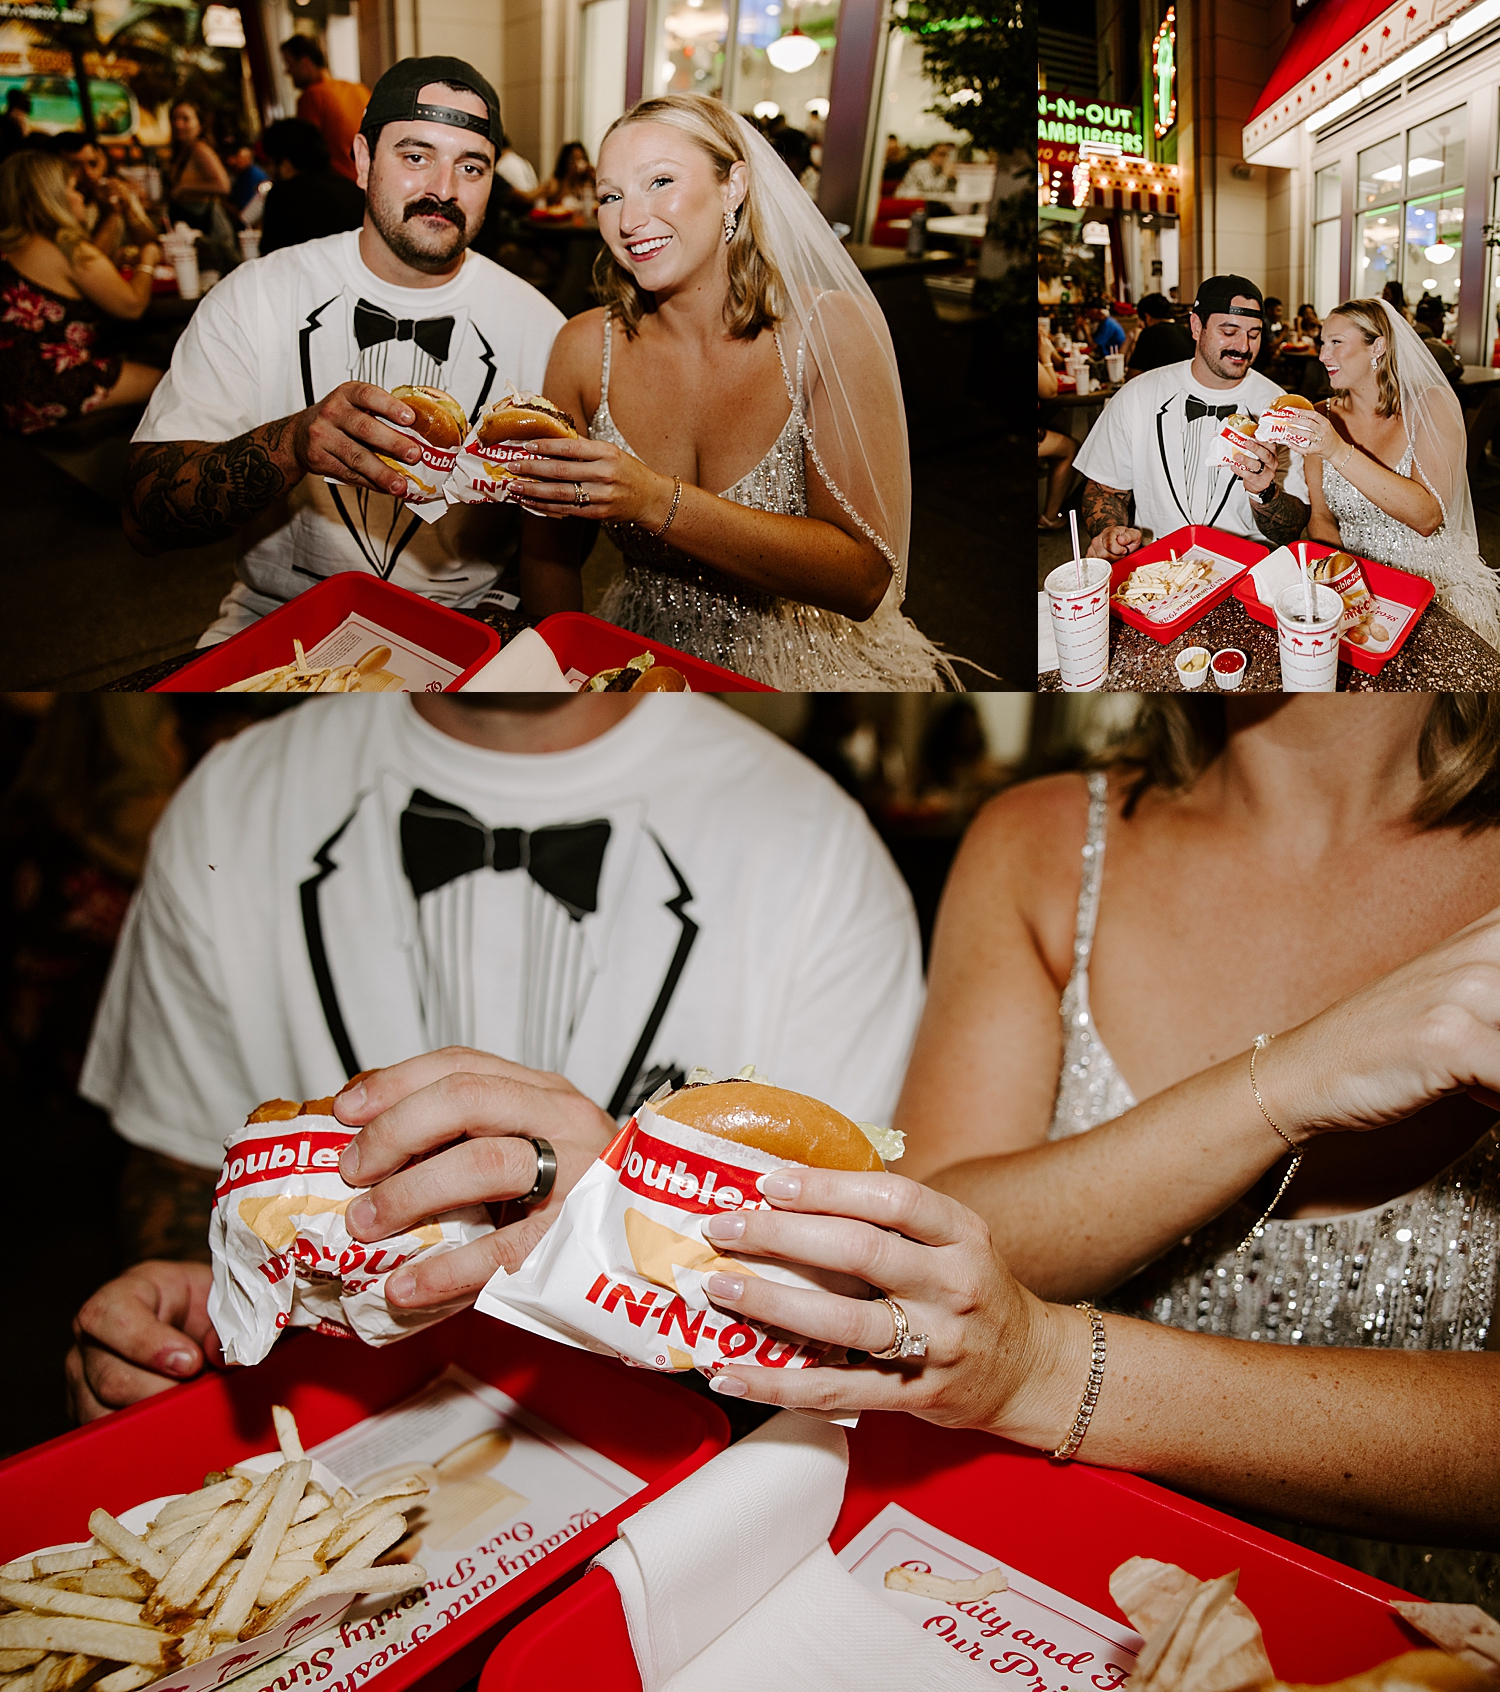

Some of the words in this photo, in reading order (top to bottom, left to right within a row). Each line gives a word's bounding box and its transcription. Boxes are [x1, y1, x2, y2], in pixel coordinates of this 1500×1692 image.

[478, 1521, 534, 1556] Our
[337, 1557, 476, 1648] Priority
[437, 1574, 496, 1625] and
[1011, 1629, 1095, 1674] and
